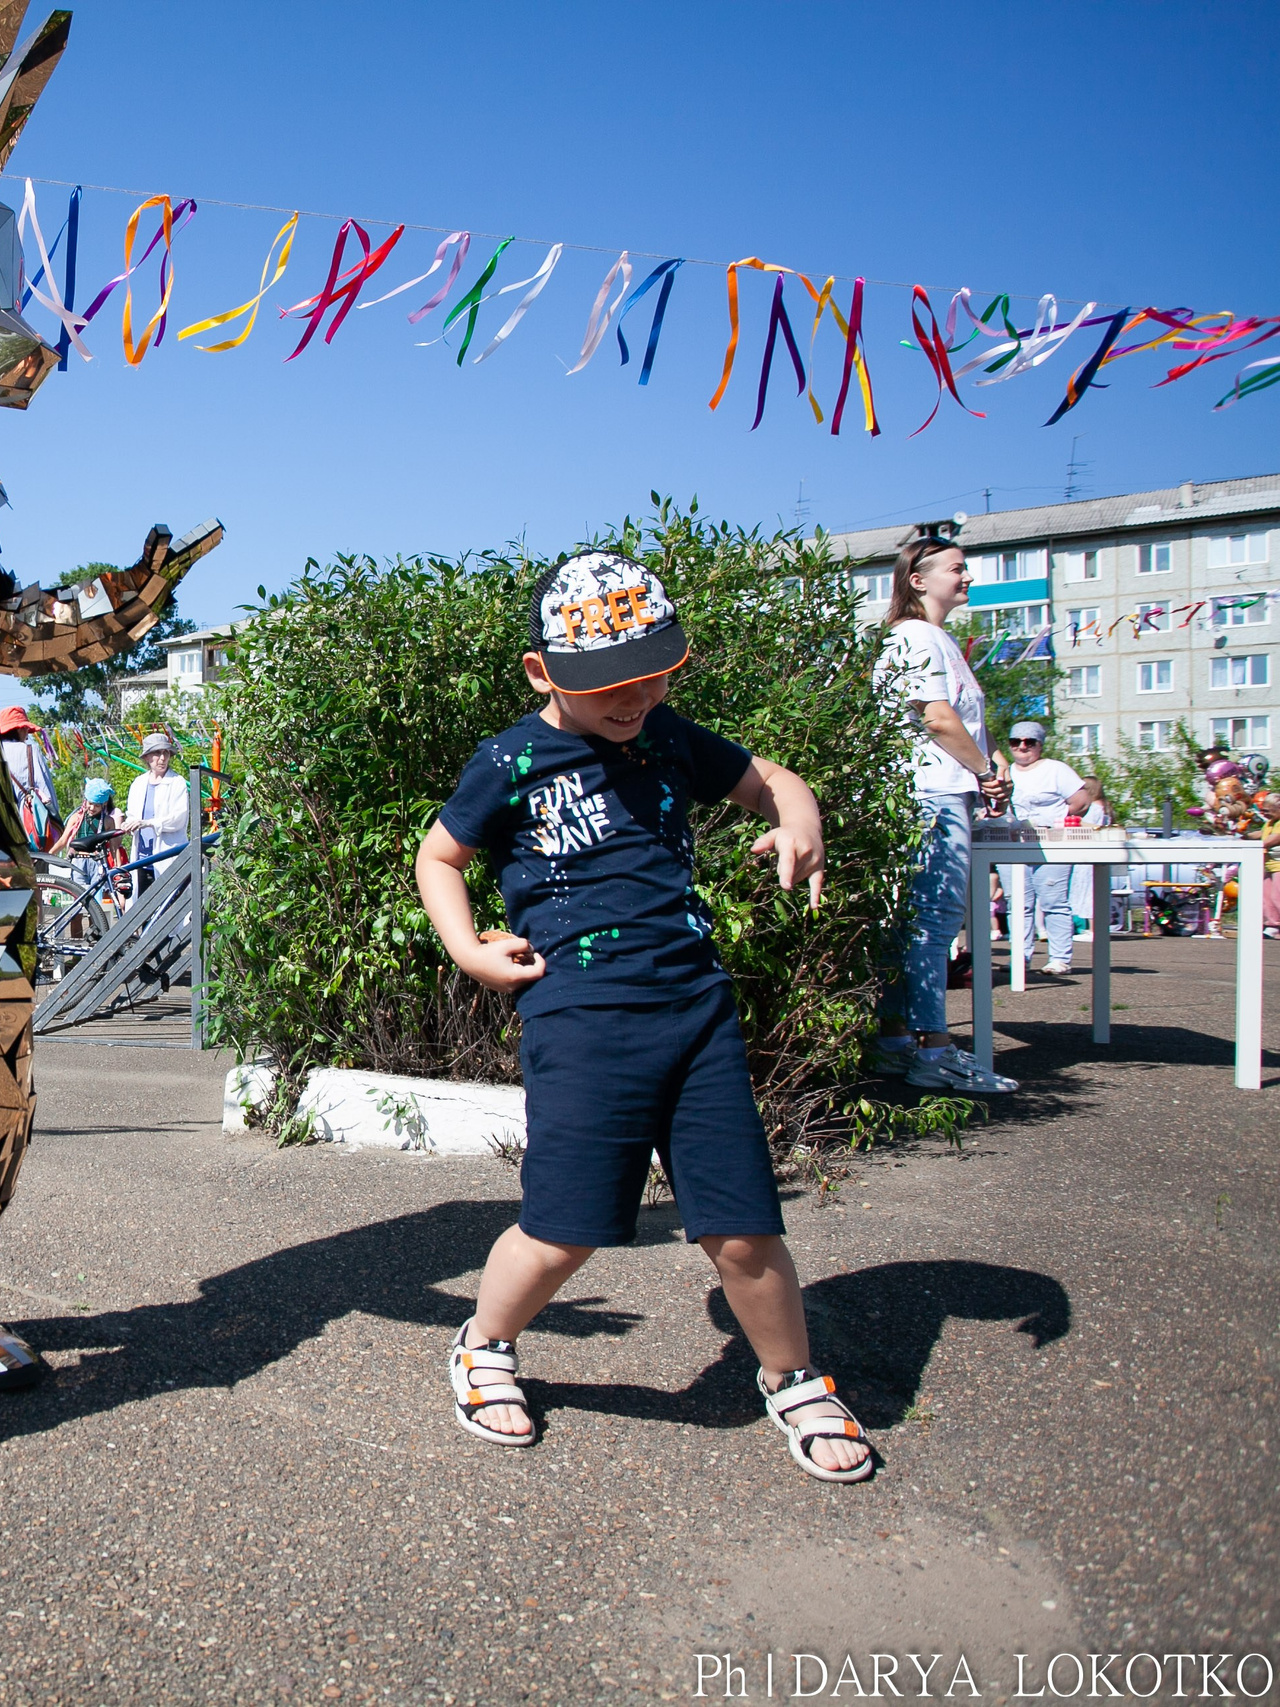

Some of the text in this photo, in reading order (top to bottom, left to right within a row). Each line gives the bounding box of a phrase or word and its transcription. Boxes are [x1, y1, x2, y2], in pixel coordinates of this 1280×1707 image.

[561, 585, 656, 644] FREE
[528, 772, 584, 819] FUN
[566, 793, 607, 818] THE
[531, 813, 617, 857] WAVE
